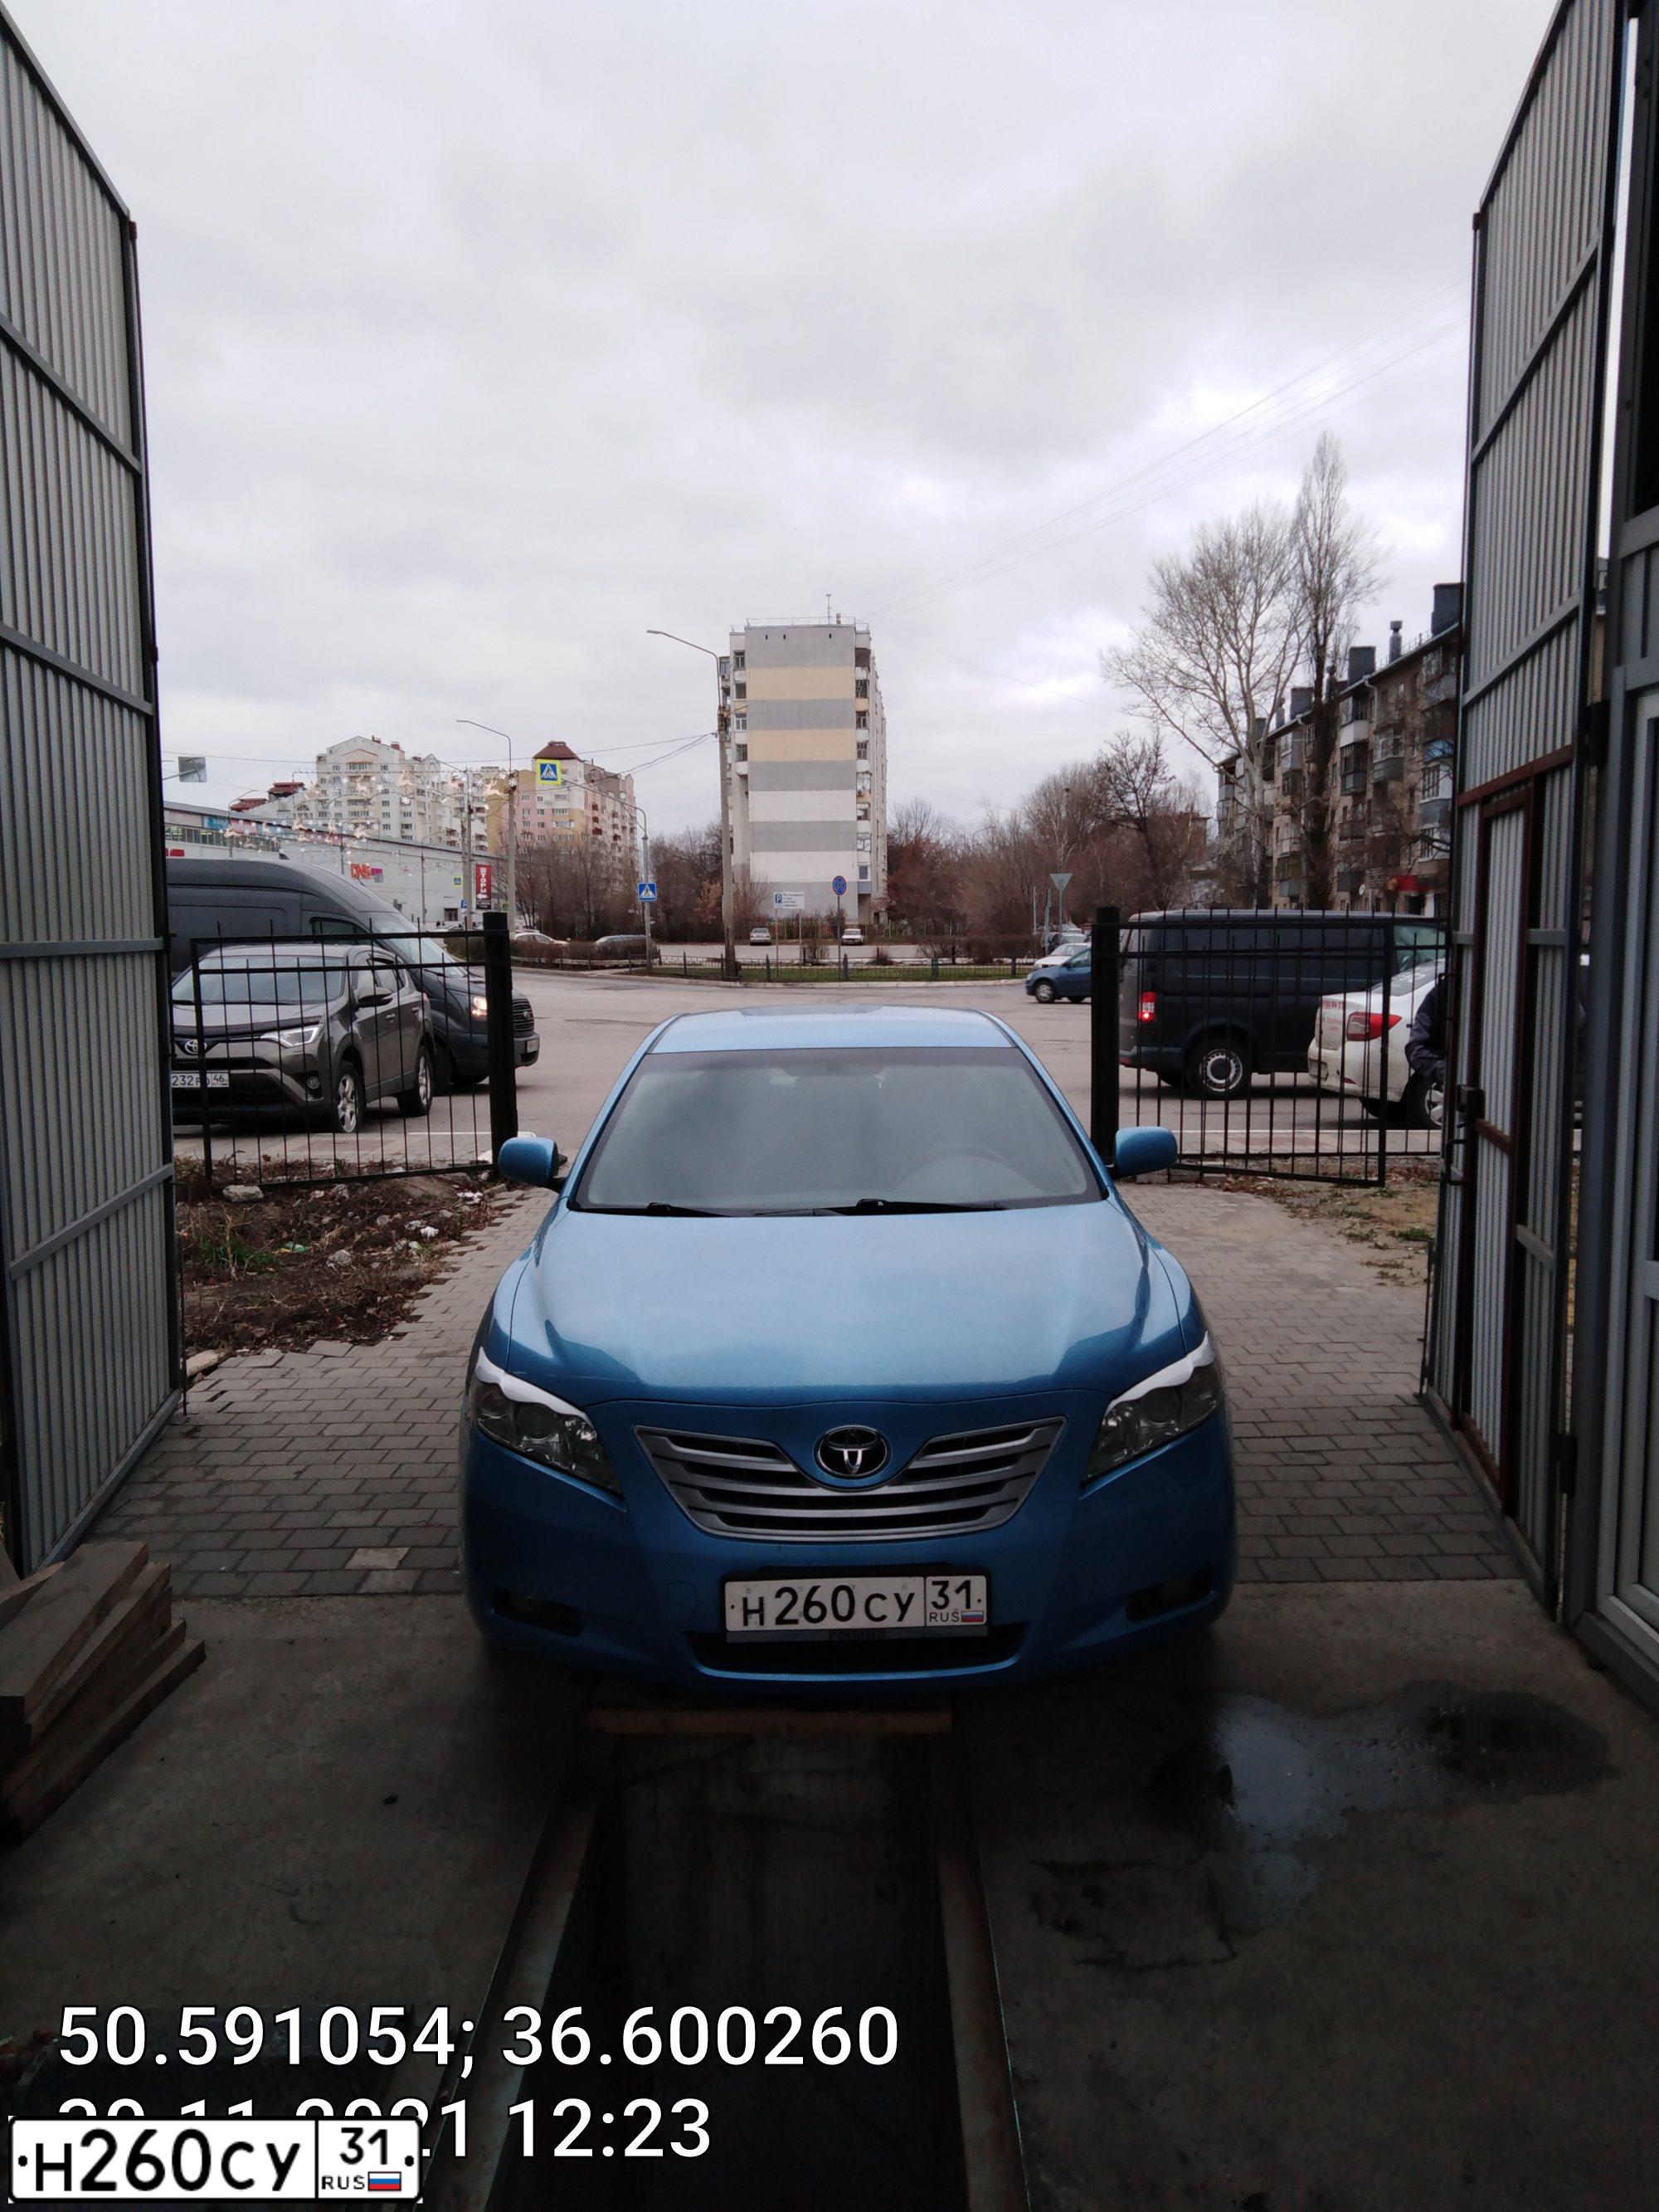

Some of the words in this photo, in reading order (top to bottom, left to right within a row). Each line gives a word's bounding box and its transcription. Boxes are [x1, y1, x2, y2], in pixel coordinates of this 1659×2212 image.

[742, 1585, 915, 1626] Н260СУ
[931, 1580, 971, 1610] 31
[929, 1612, 960, 1623] RUS
